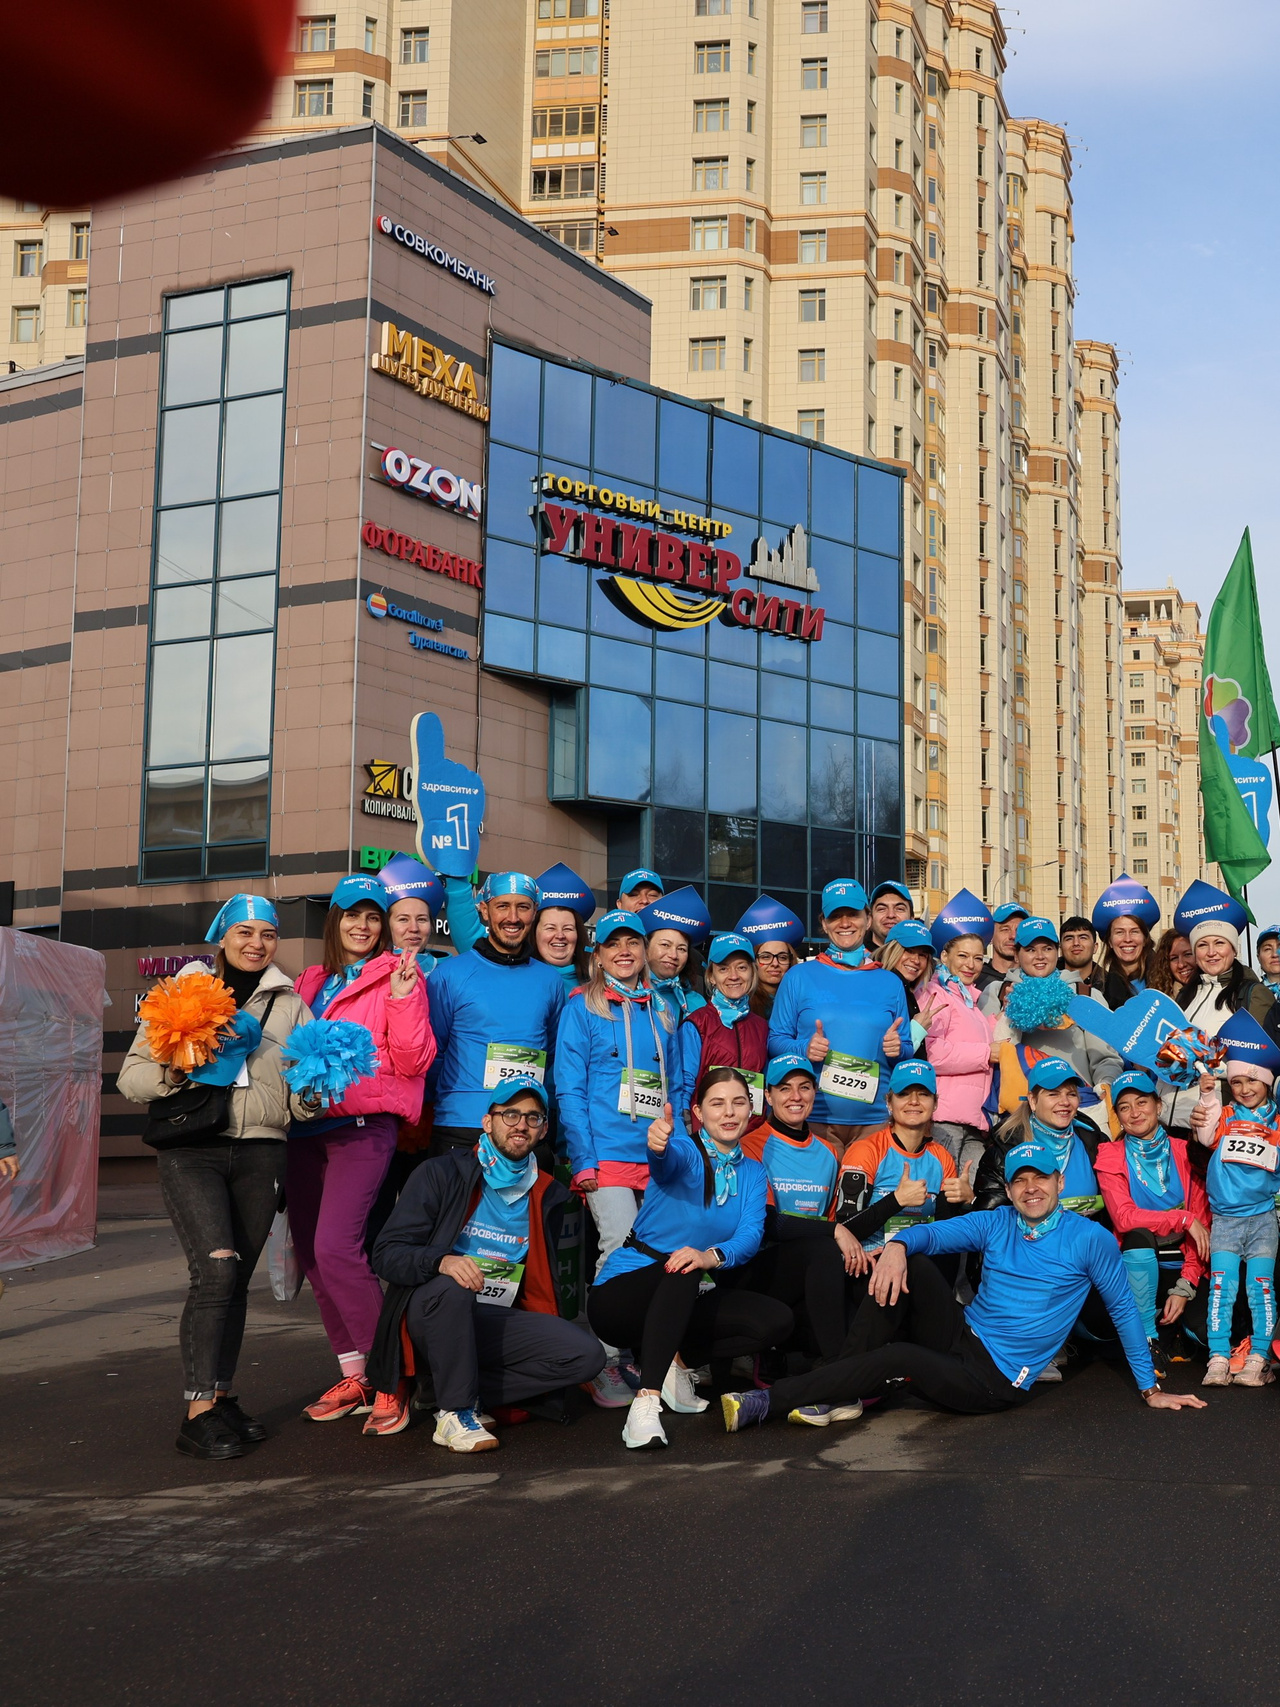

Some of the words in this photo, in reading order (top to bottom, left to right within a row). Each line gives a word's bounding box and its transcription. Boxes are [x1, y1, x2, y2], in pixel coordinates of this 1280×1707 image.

[394, 224, 496, 296] СОВКОМБАНК
[381, 321, 478, 399] МЕХА
[381, 446, 482, 515] OZON
[673, 508, 733, 538] ЦЕНТР
[362, 521, 484, 589] ФОРАБАНК
[543, 502, 742, 595] УНИВЕР
[731, 588, 826, 642] СИТИ
[421, 782, 472, 795] здравсити
[1102, 898, 1144, 908] здравсити
[1180, 903, 1224, 919] здравсити
[653, 909, 700, 927] здравсити
[943, 916, 985, 925] здравсити
[742, 922, 788, 934] здравсити
[1122, 1006, 1157, 1054] здравсити
[1220, 1036, 1260, 1050] здравсити
[831, 1074, 867, 1091] 52279
[634, 1093, 662, 1108] 52258
[1226, 1138, 1266, 1157] 3237
[772, 1181, 824, 1193] здравсити
[1211, 1289, 1222, 1332] здравсити
